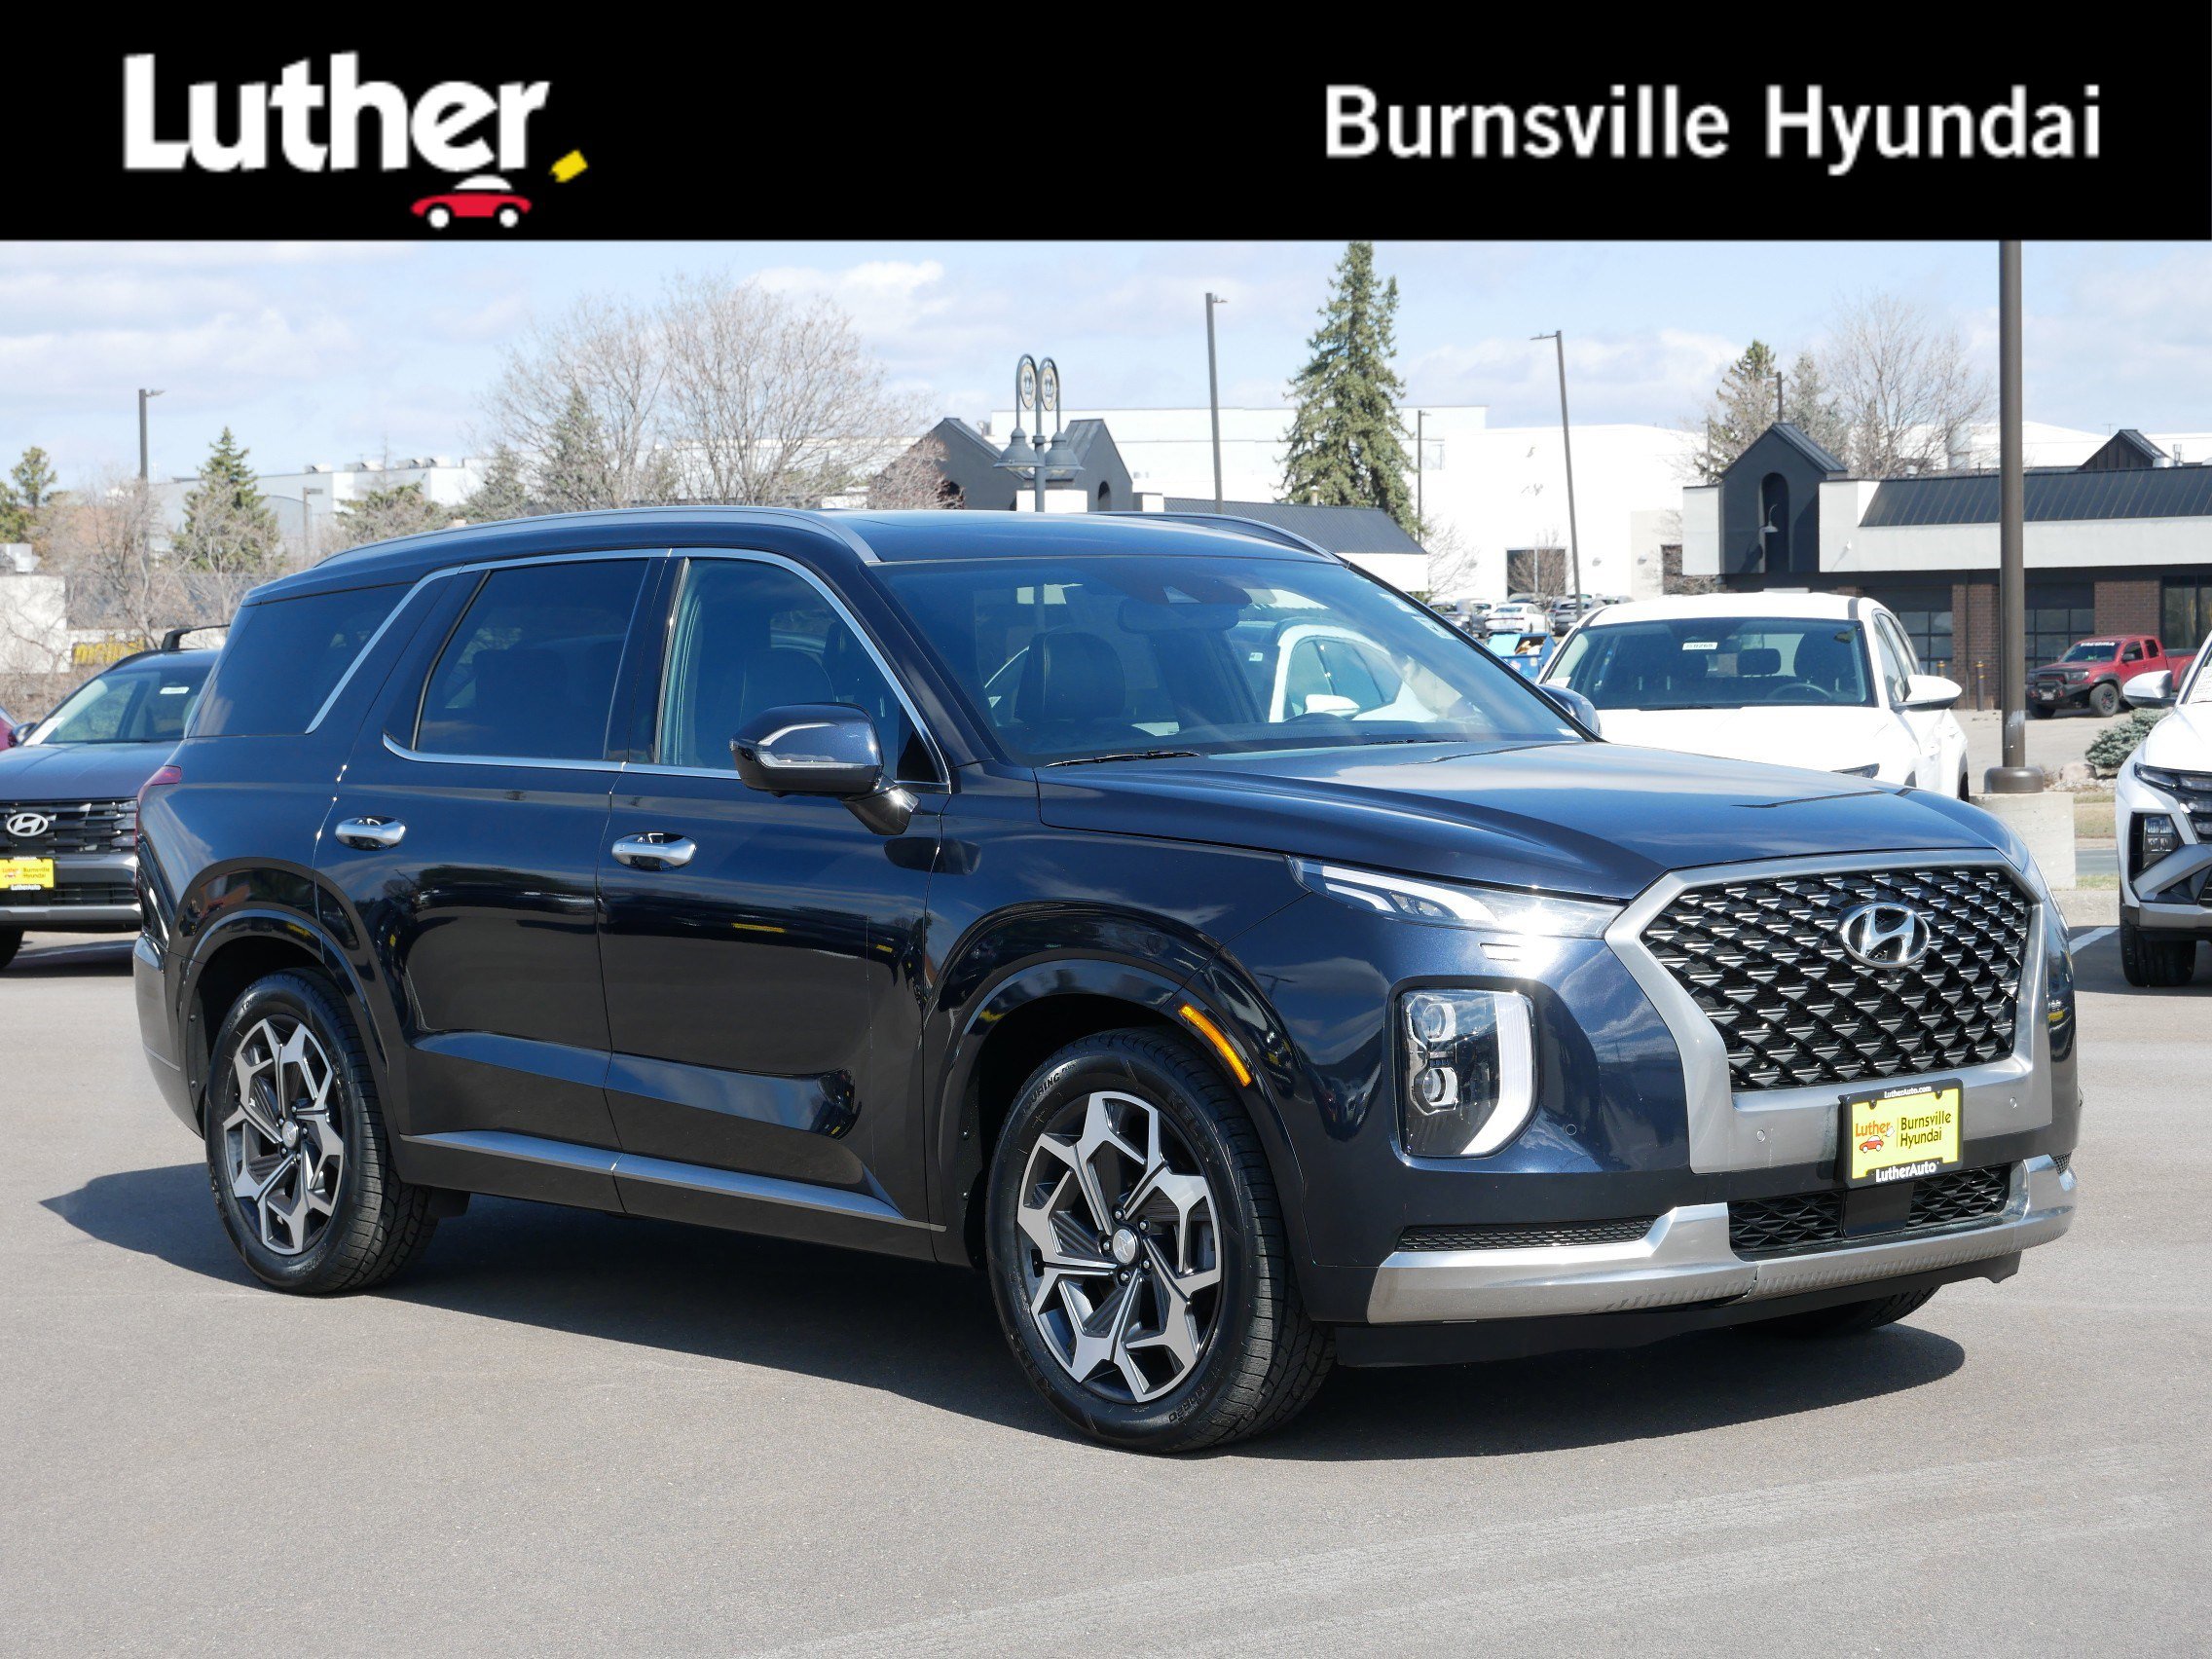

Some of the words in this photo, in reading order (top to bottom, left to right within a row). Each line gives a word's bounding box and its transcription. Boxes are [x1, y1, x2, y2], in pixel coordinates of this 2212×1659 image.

[1884, 1086, 1932, 1098] LutherAuto.com
[1855, 1121, 1892, 1137] Luther
[1900, 1111, 1951, 1130] Burnsville
[1900, 1127, 1942, 1149] Hyundai
[1875, 1161, 1936, 1183] LutherAuto
